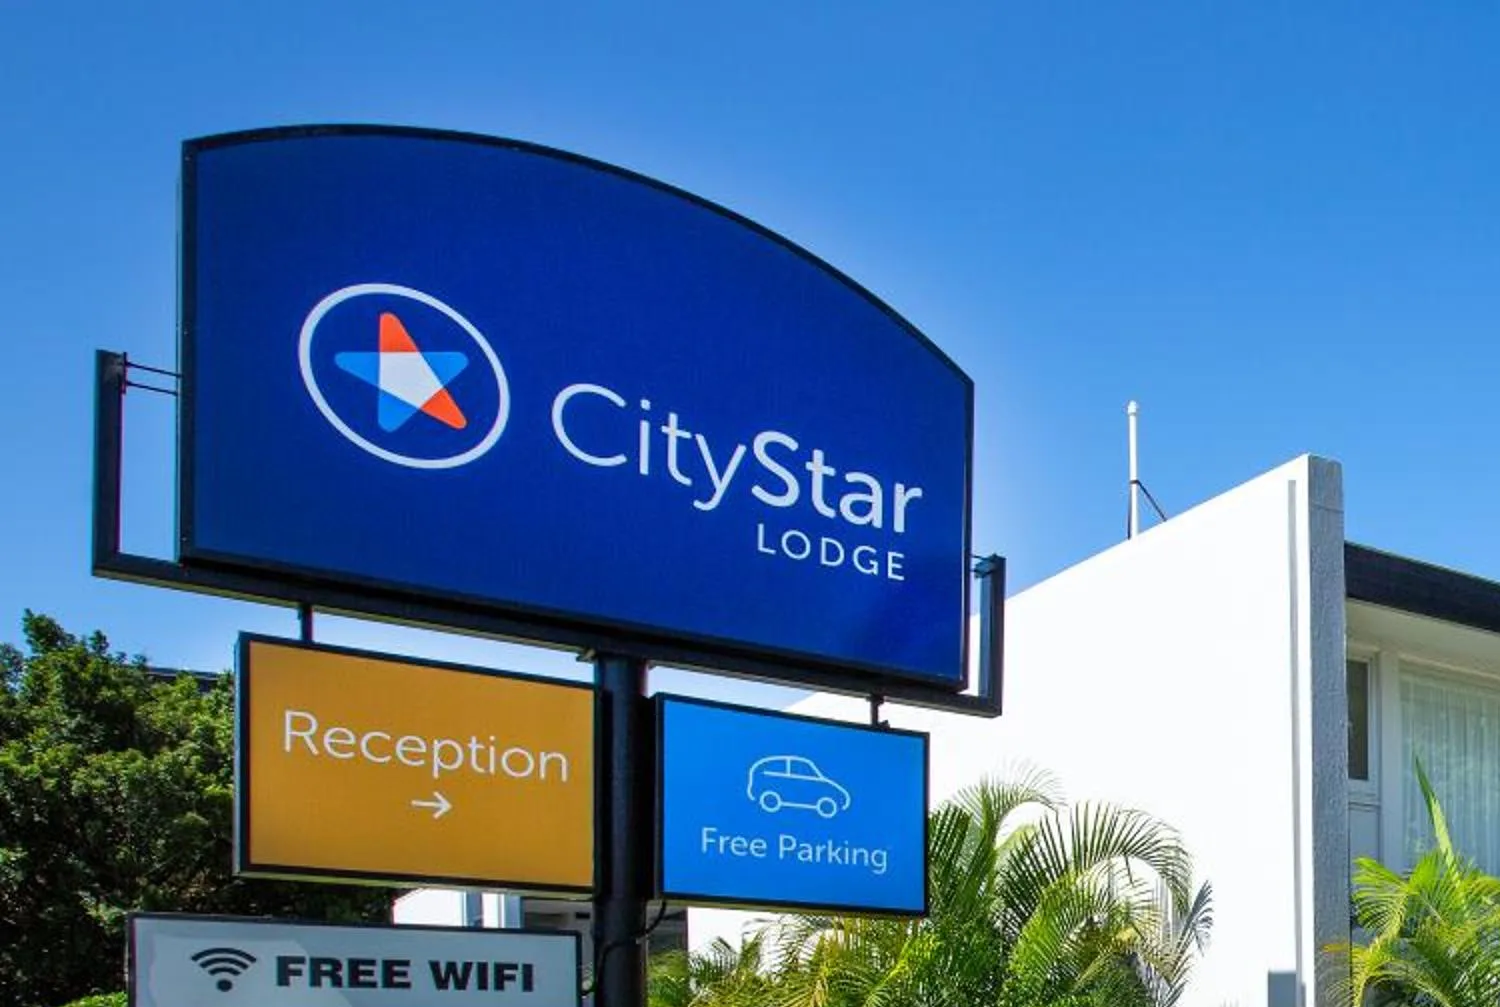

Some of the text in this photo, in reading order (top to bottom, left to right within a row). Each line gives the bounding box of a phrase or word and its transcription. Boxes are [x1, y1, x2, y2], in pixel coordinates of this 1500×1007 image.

[550, 382, 923, 534] CityStar
[757, 522, 906, 582] LODGE
[283, 708, 570, 783] Reception
[701, 826, 888, 874] Free Parking
[275, 954, 535, 994] FREE WIFI
